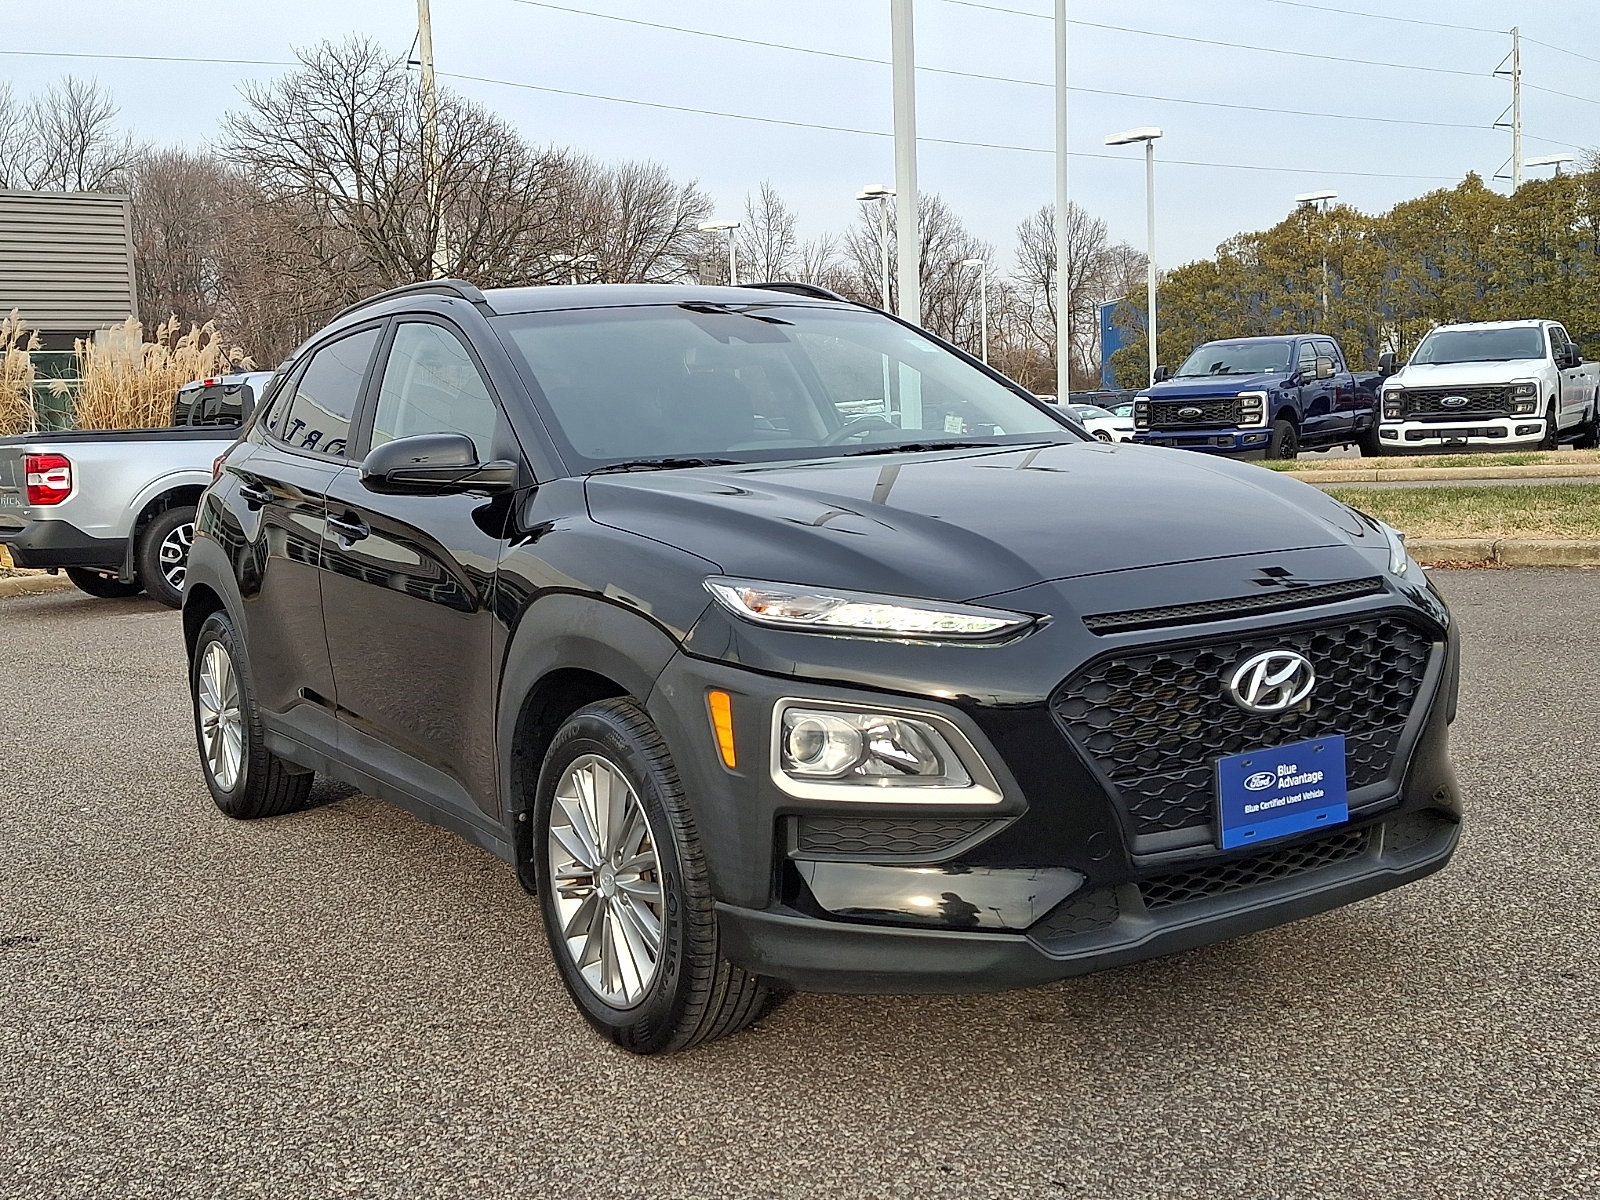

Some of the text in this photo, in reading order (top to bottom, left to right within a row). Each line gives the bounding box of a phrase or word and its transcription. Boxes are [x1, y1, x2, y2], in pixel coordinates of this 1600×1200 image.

[1277, 764, 1297, 777] Blue
[1247, 773, 1273, 789] Ford
[1278, 771, 1324, 789] Advantage
[1244, 789, 1324, 813] Blue Certified Used Vehicle
[664, 871, 678, 977] SOLUS
